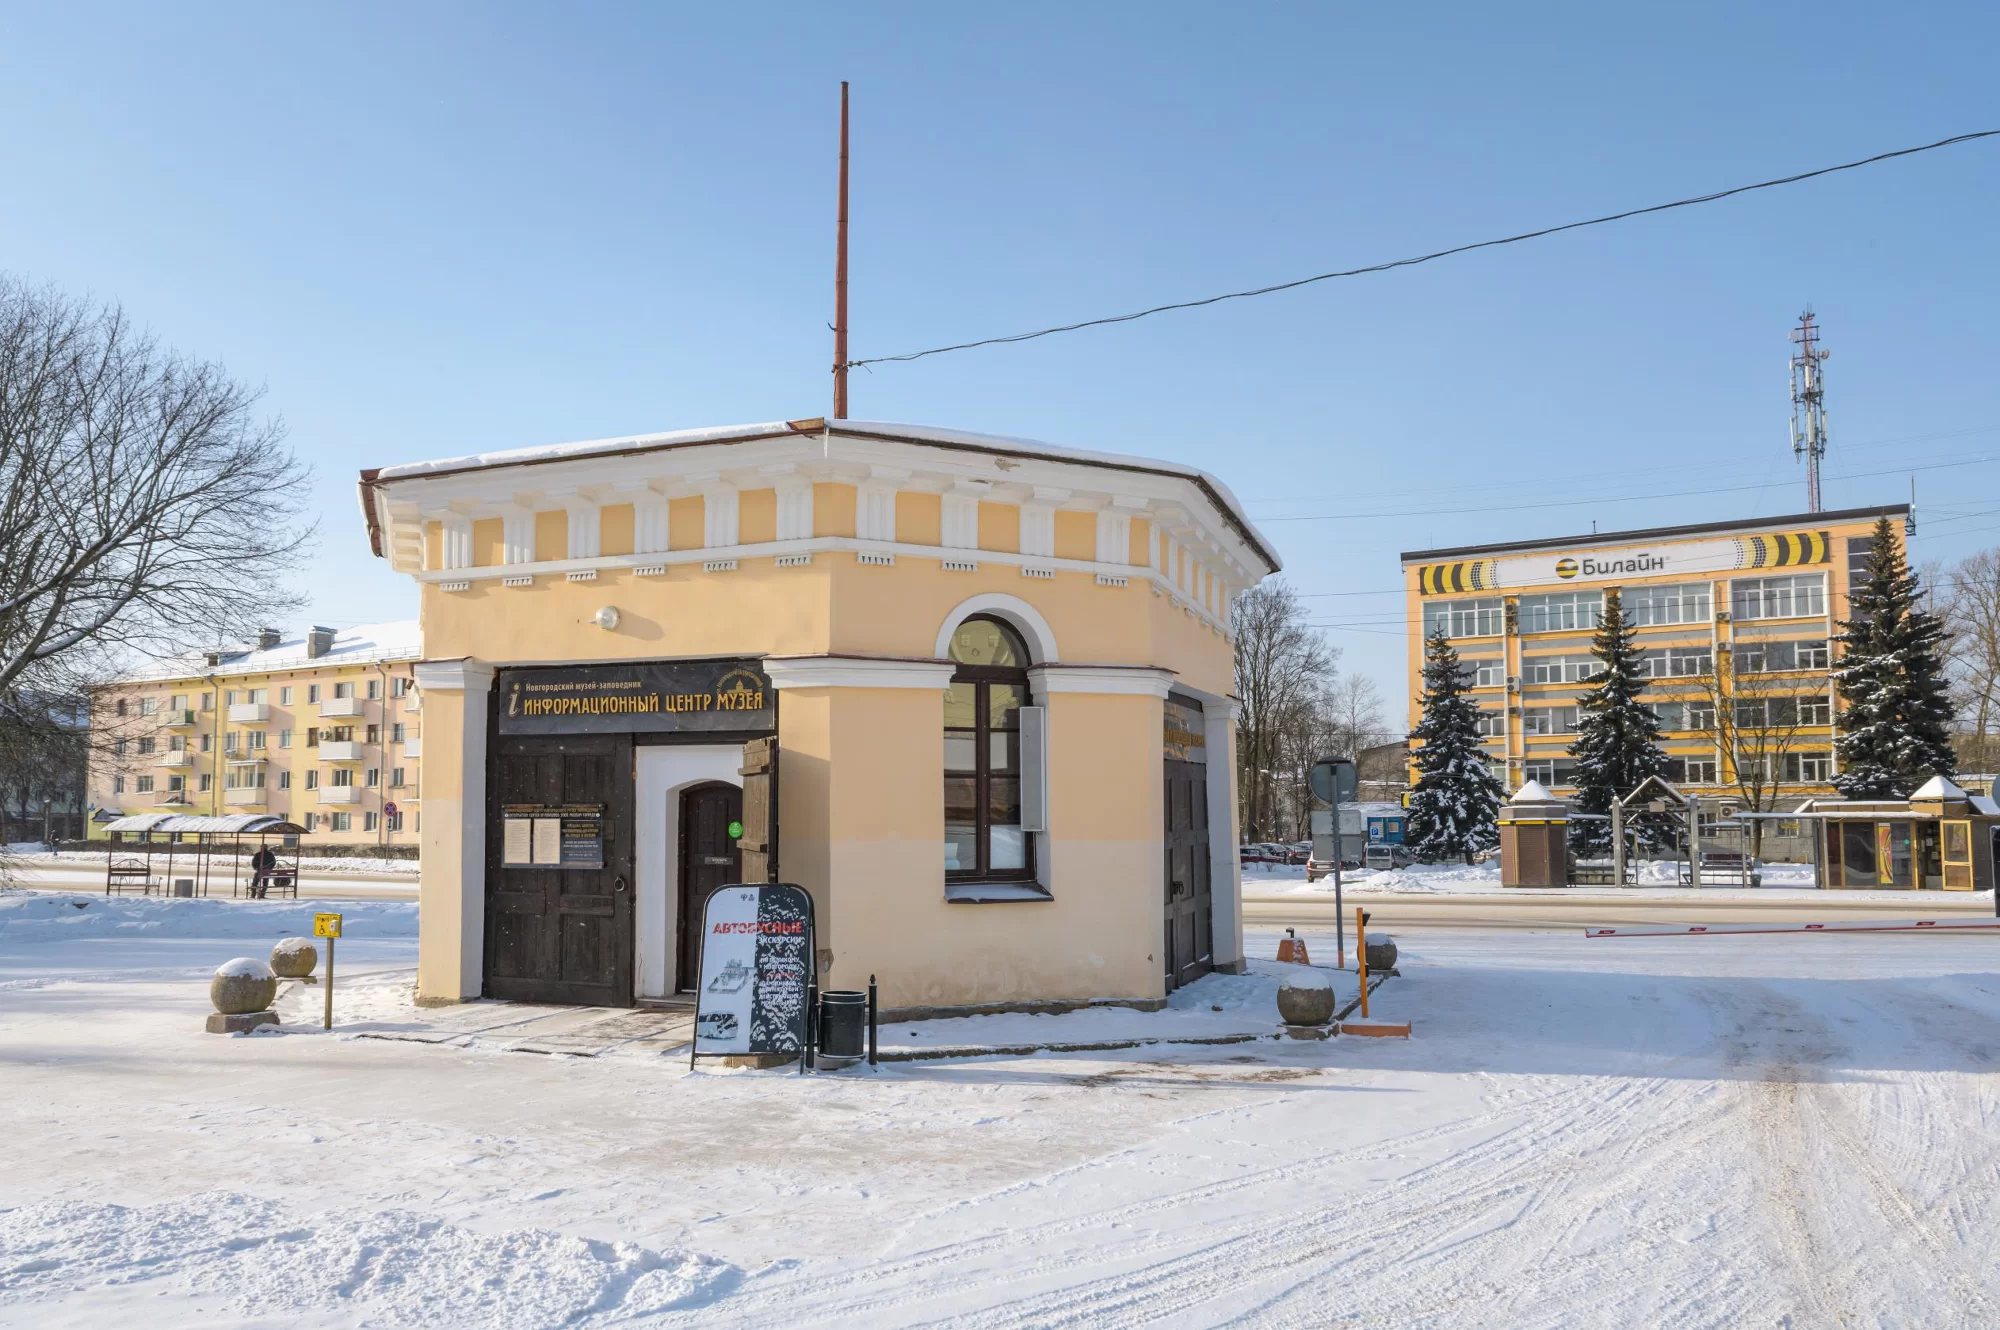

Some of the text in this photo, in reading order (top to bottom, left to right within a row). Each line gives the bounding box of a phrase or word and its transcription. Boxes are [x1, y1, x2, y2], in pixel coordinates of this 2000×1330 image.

[1583, 553, 1664, 575] Билайн
[525, 681, 642, 692] Новгородский музей-заповедник
[523, 692, 763, 715] ИНФОРМАЦИОННЫЙ ЦЕНТР МУЗЕЯ
[713, 921, 803, 934] АВТОБУСНЫЕ
